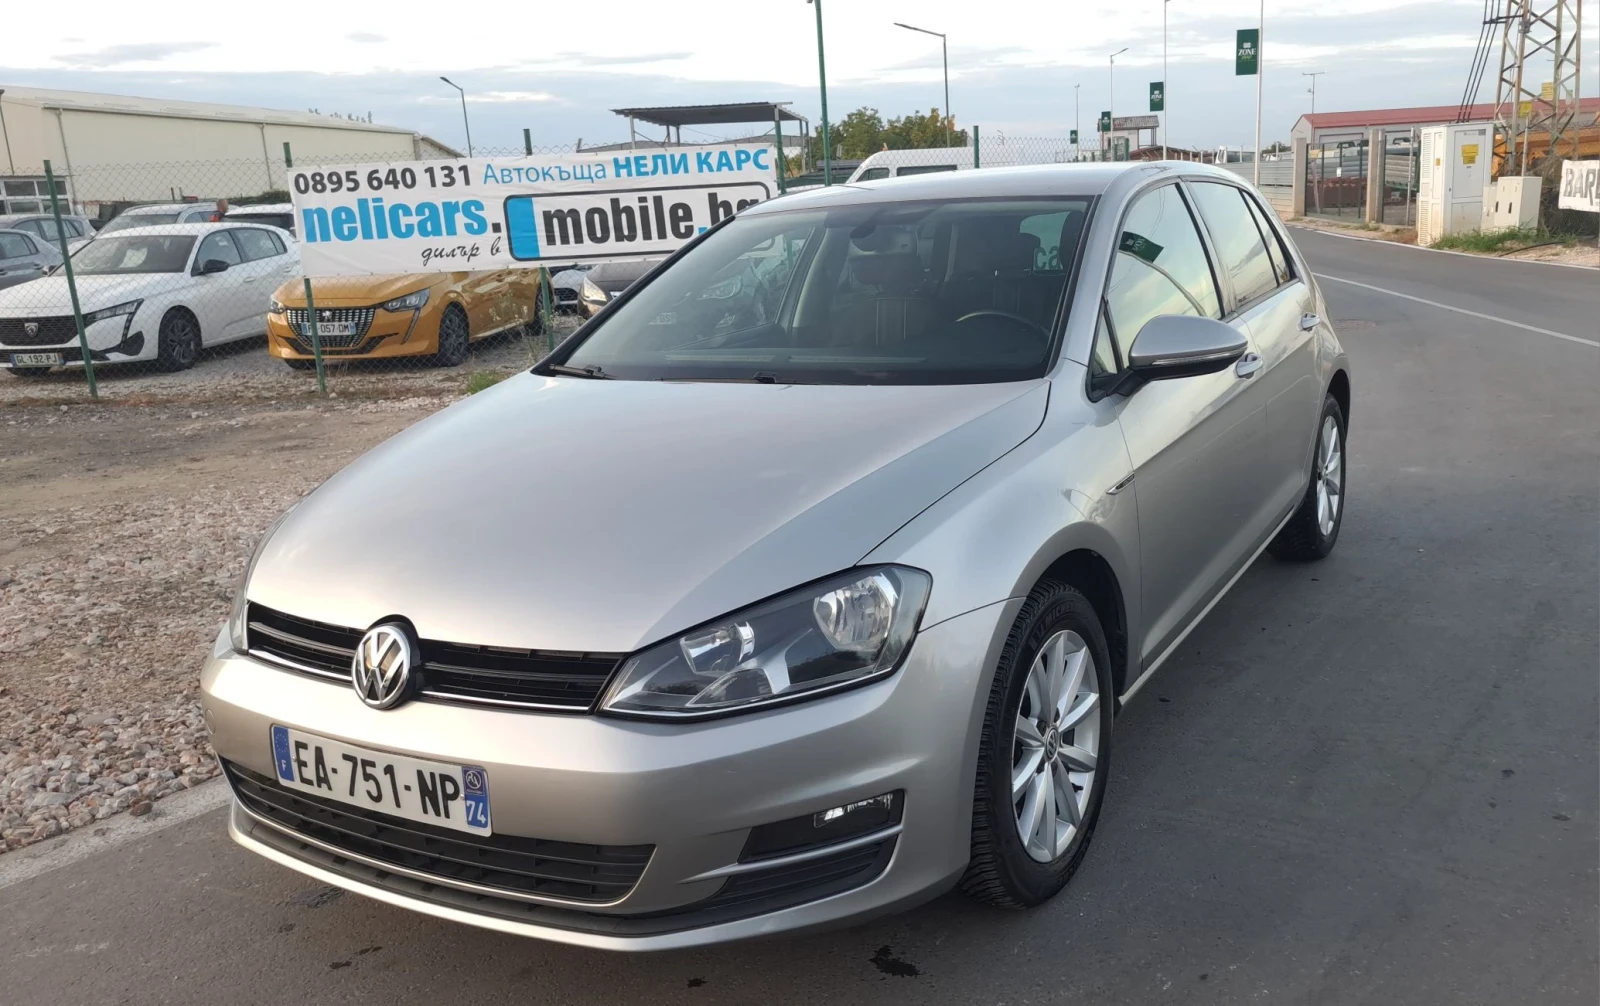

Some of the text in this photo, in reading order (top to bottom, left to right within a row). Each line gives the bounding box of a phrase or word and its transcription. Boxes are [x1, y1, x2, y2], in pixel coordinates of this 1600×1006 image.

[1238, 48, 1256, 56] ZONE
[294, 164, 471, 195] 0895 640 131
[483, 149, 770, 185] Автокъща НЕЛИ КАРС
[421, 242, 482, 266] дилър
[279, 758, 288, 772] F
[294, 739, 460, 819] EA-751-NP
[466, 799, 487, 825] 74
